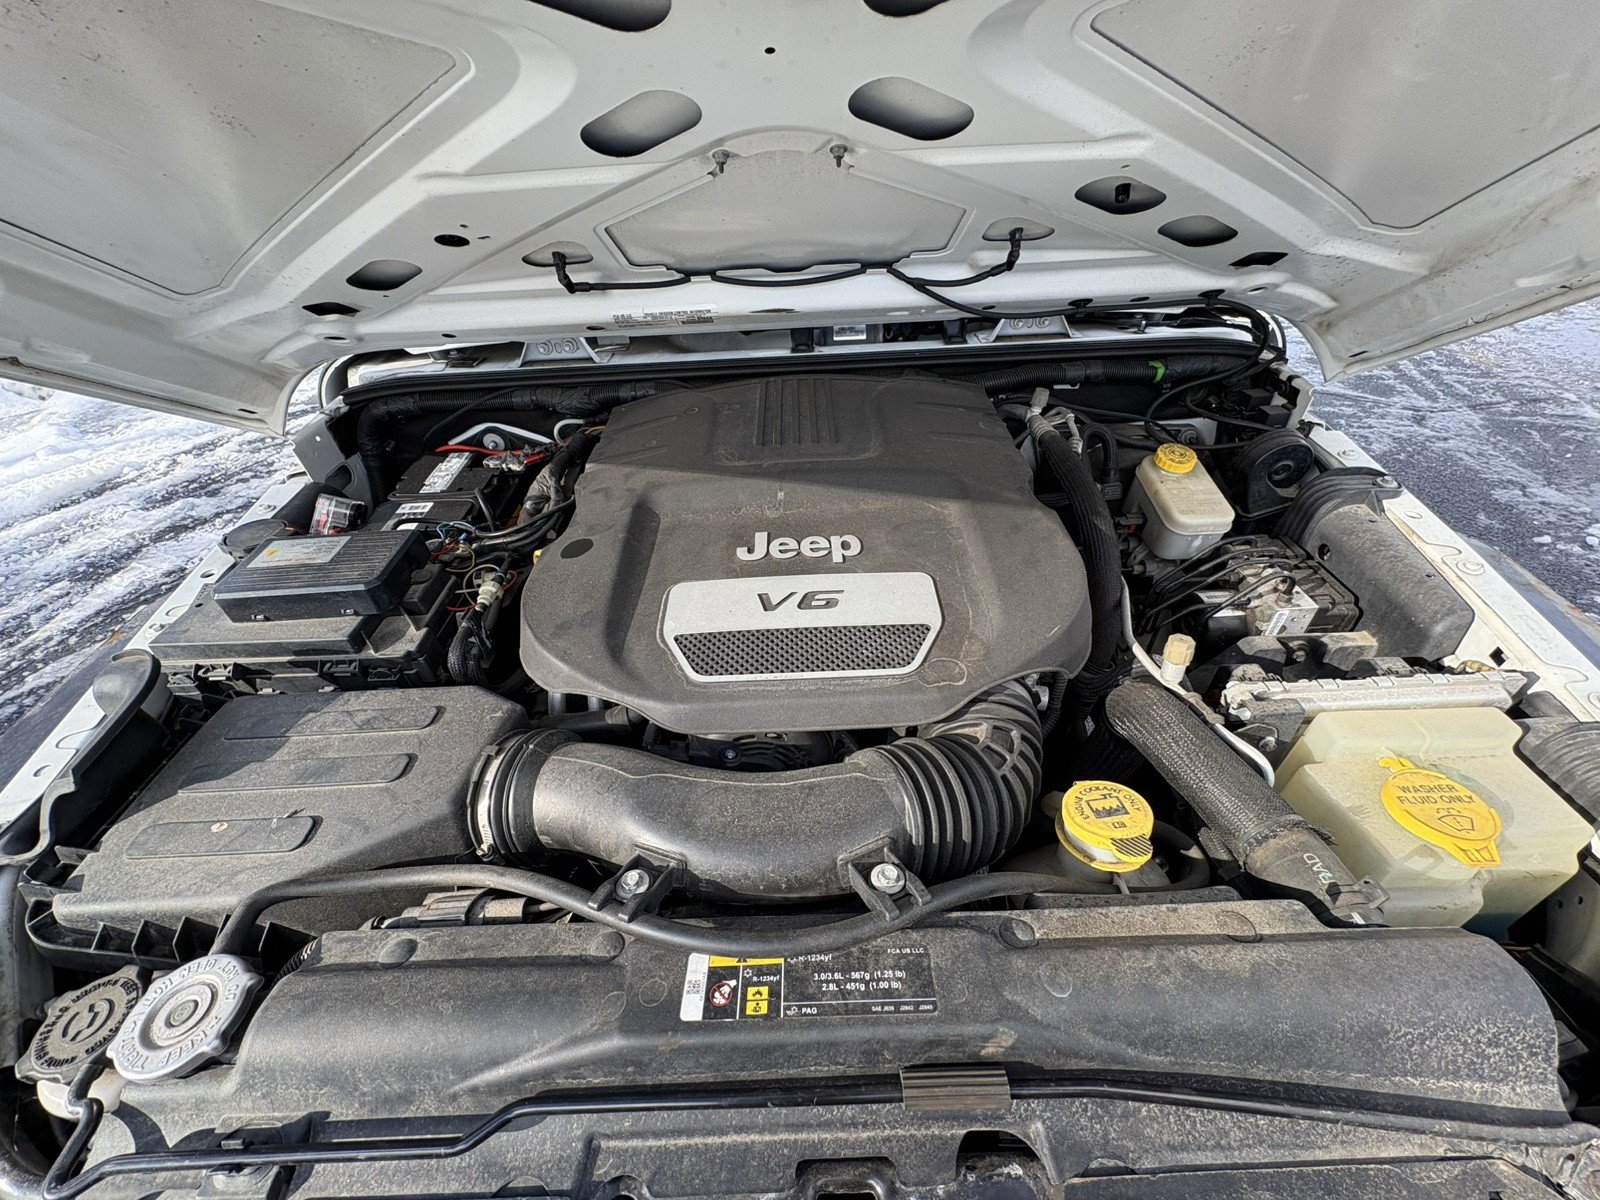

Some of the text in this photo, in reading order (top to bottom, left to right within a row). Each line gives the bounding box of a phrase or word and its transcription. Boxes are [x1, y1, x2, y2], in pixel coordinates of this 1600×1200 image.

[736, 532, 861, 563] Jeep
[757, 590, 844, 612] V6
[1398, 784, 1459, 793] WASHER
[1079, 785, 1123, 796] COOLANT
[1124, 793, 1141, 812] ONLY
[1397, 794, 1475, 805] FLUID ONLY
[1303, 853, 1336, 884] RAD
[753, 975, 780, 983] R-1234yf
[813, 972, 844, 980] 3.0/3.6L
[851, 971, 870, 980] 567g
[874, 970, 893, 979] (1.25
[895, 970, 906, 979] lb)
[821, 983, 839, 991] 2.8L
[846, 982, 866, 991] 451g
[869, 981, 889, 990] (1.00
[891, 981, 902, 989] lb)
[159, 1030, 208, 1065] KEEP
